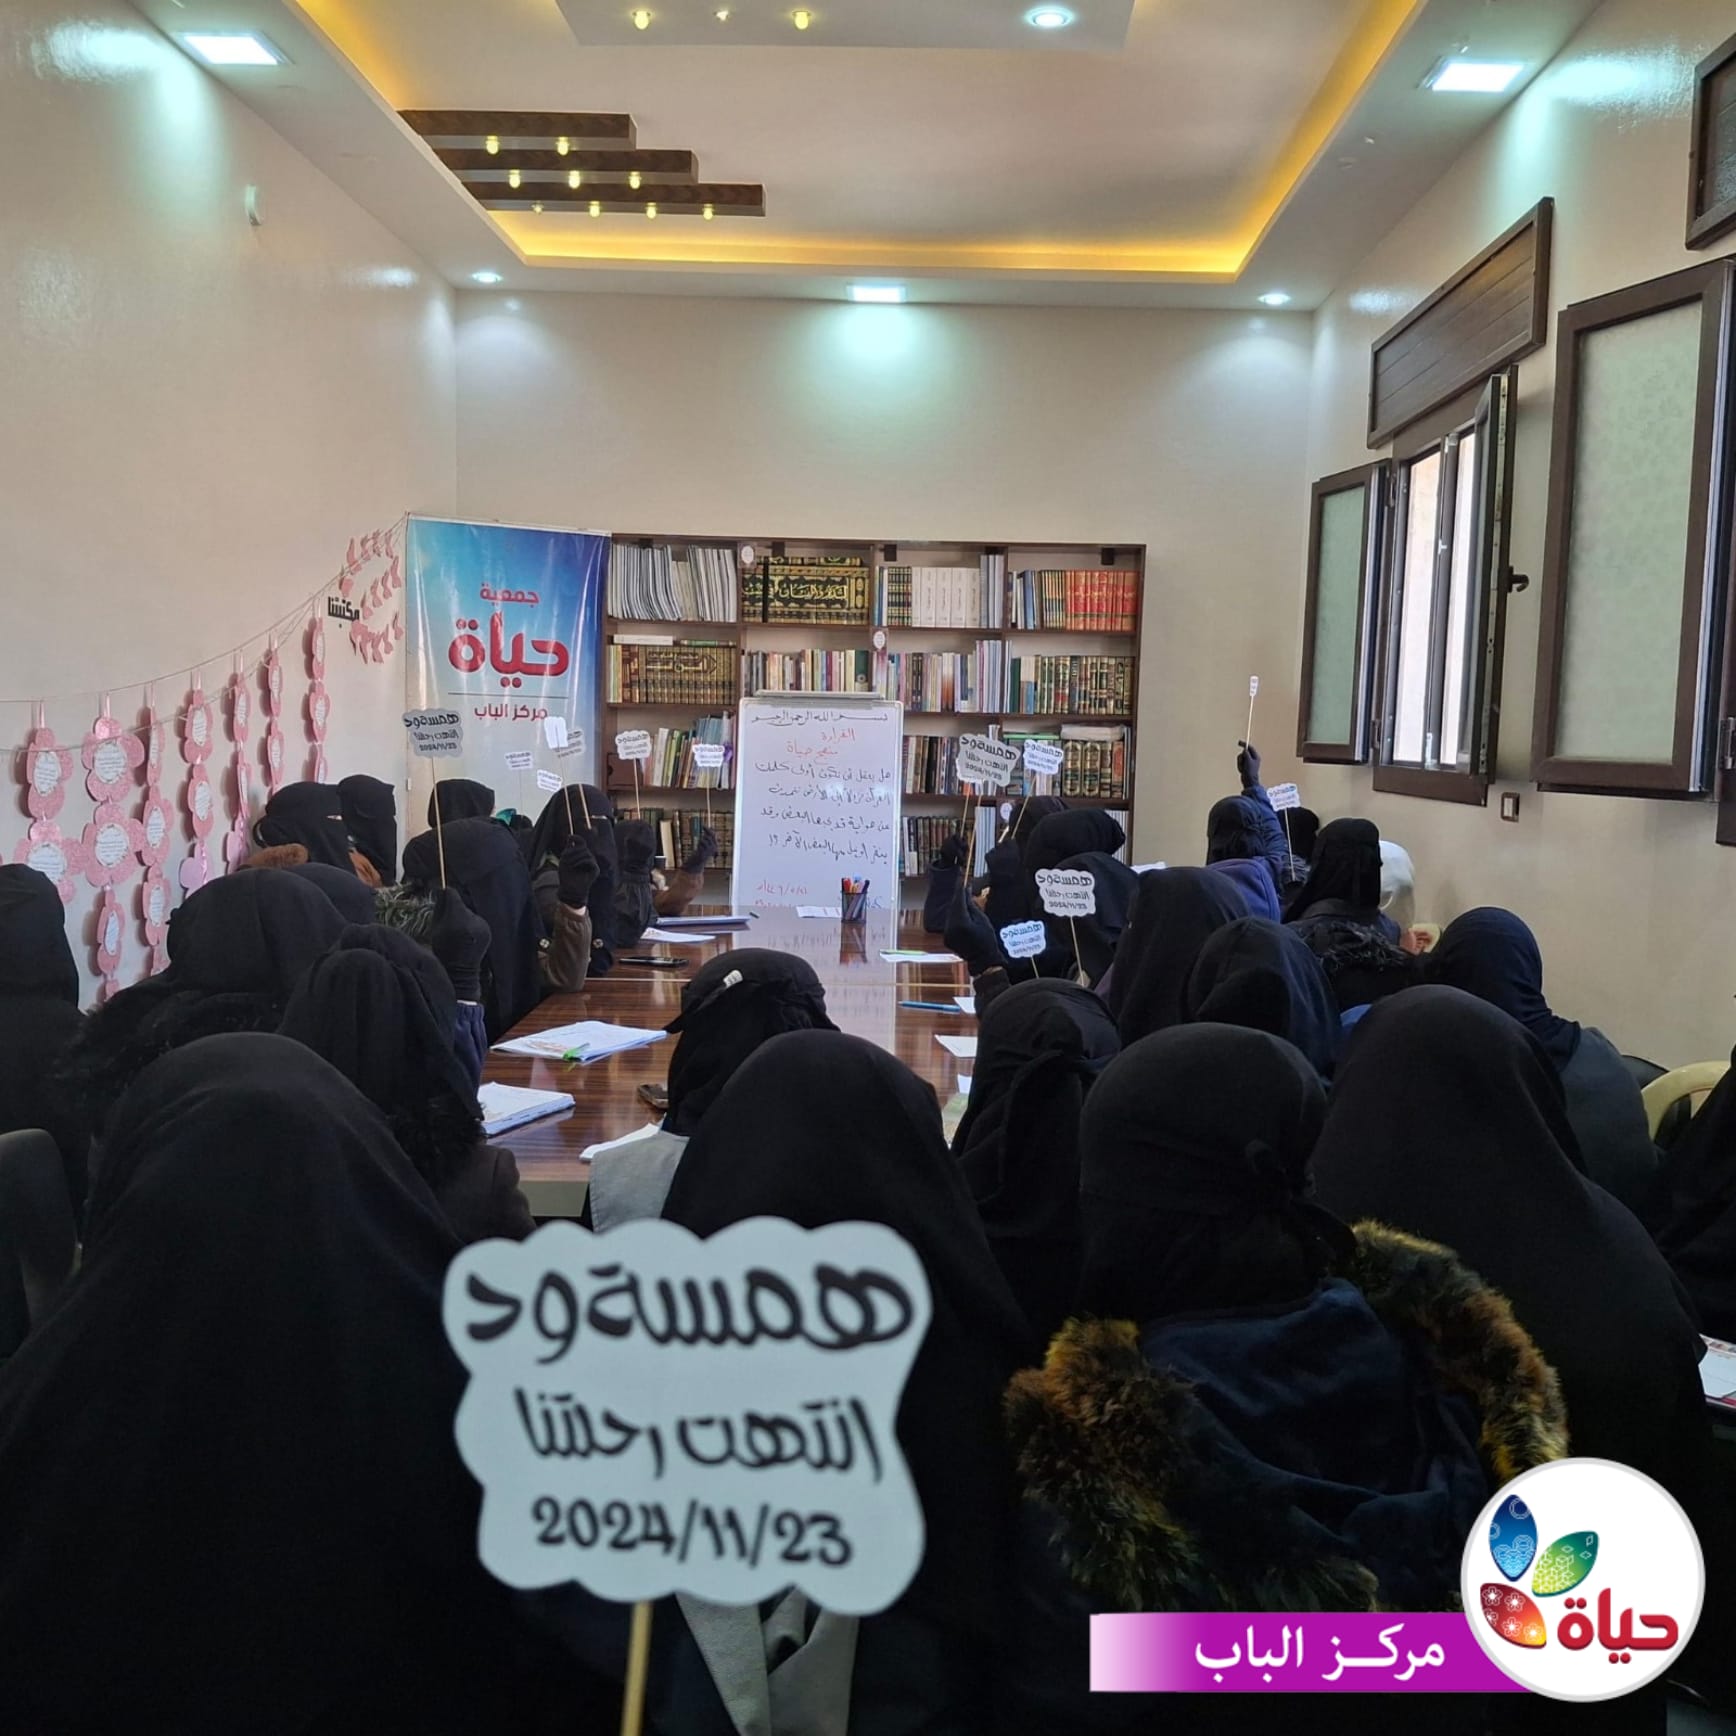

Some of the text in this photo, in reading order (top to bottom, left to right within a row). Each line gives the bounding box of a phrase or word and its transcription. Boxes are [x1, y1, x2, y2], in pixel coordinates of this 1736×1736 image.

[479, 583, 540, 608] جمعية
[327, 596, 361, 628] مكتبتنا
[447, 611, 570, 689] حياة
[474, 702, 548, 722] مركز الباب
[786, 739, 814, 758] حياة
[513, 1386, 884, 1486] انتهت رحلتنا
[530, 1496, 854, 1569] 2024/11/23
